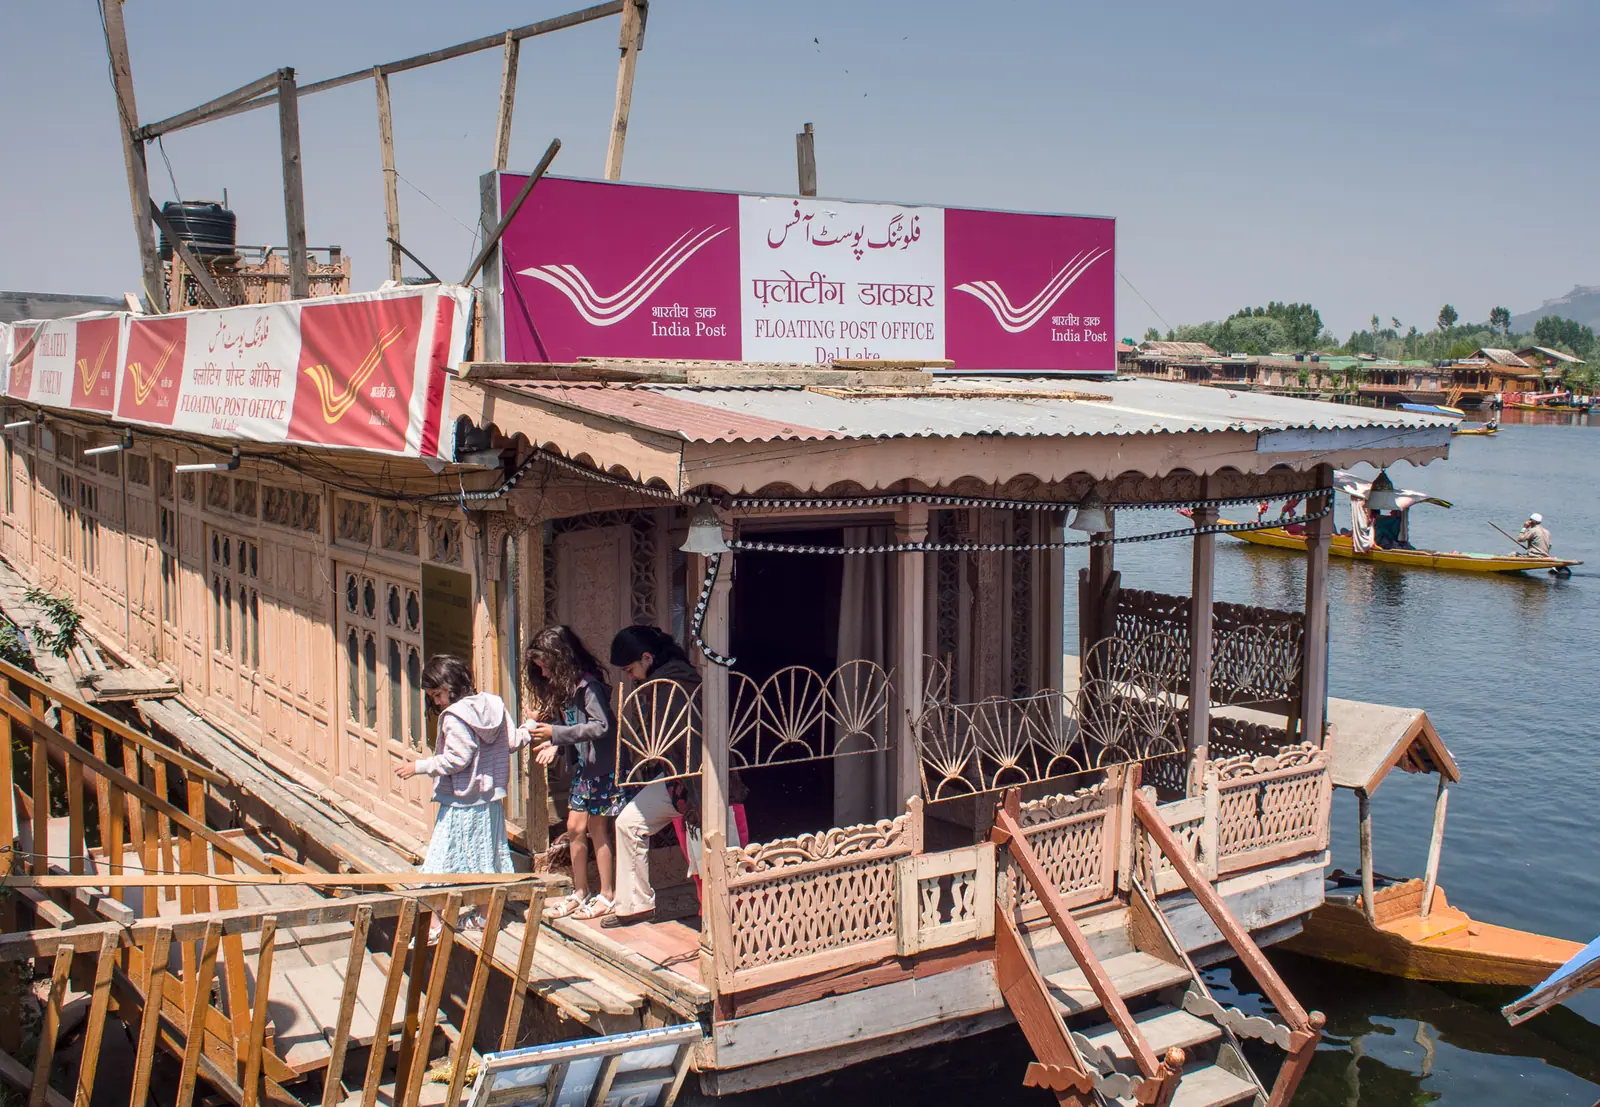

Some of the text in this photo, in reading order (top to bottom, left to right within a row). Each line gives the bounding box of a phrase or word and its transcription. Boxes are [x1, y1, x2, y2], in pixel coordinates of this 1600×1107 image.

[767, 200, 921, 261] فلوٹنگ پوسٹ آفس
[857, 283, 936, 308] डाकघर
[651, 302, 717, 318] भारतीय डाक
[1051, 312, 1101, 326] भारतीय डाक
[651, 321, 727, 337] India Post
[754, 318, 936, 341] FLOATING POST OFFICE
[1051, 328, 1108, 342] India Post
[815, 346, 840, 365] Dal
[180, 394, 223, 415] FLOATING
[223, 396, 249, 417] POST
[248, 398, 287, 420] OFFICE
